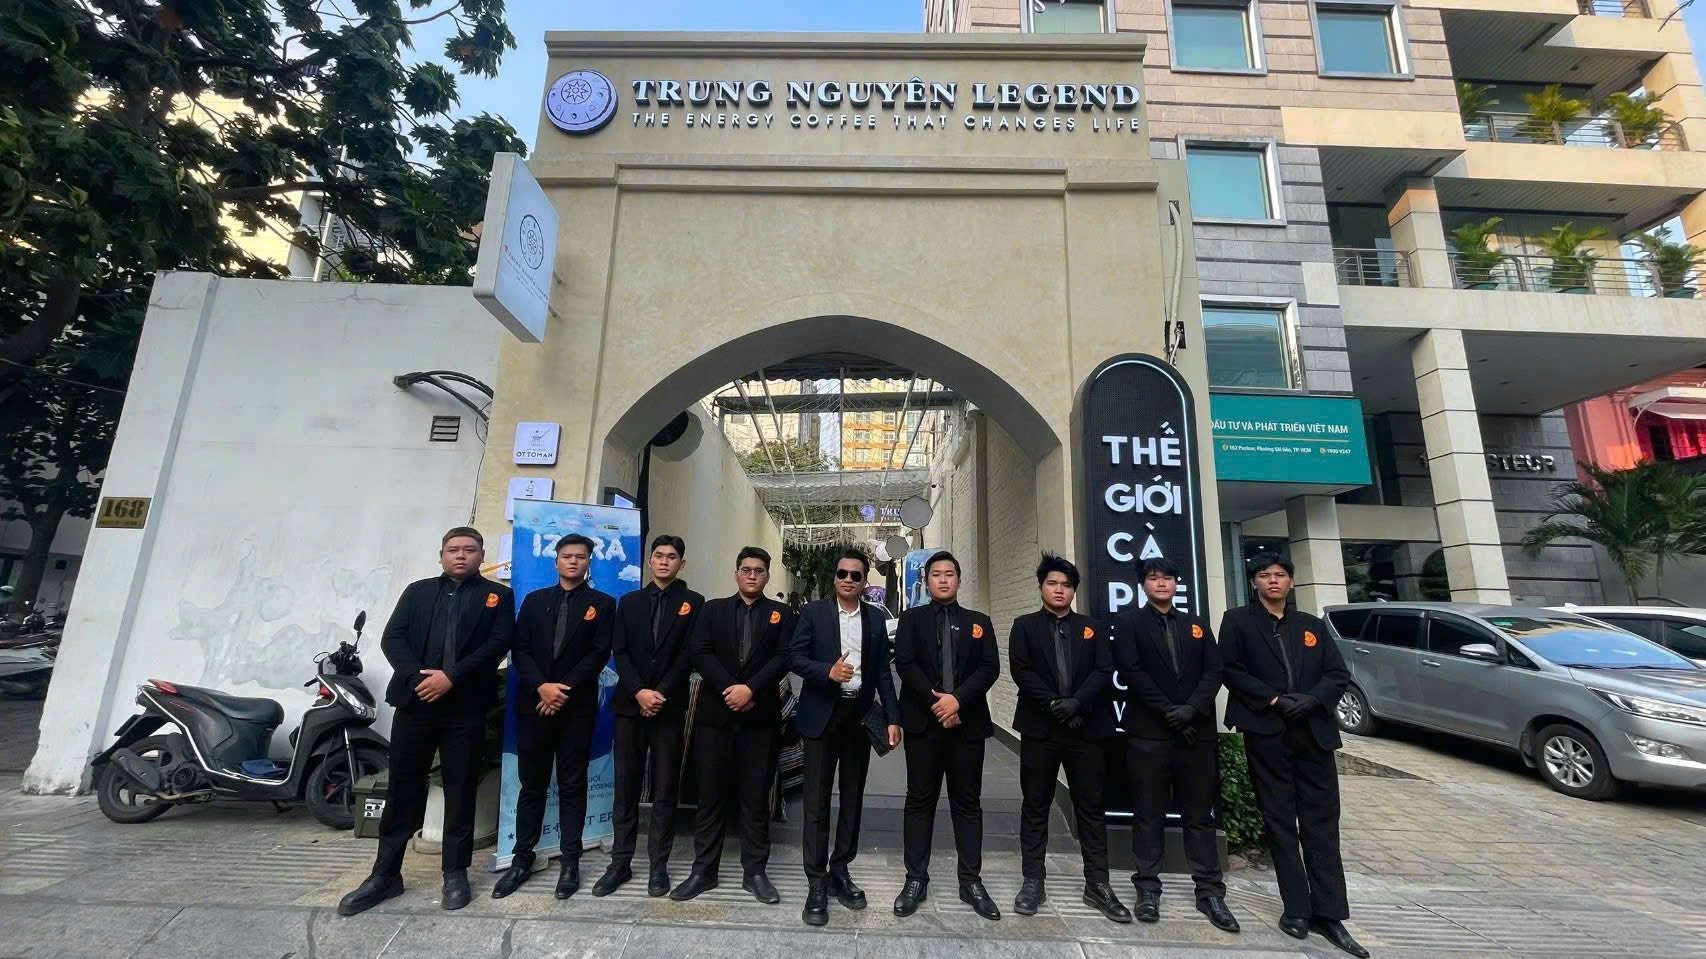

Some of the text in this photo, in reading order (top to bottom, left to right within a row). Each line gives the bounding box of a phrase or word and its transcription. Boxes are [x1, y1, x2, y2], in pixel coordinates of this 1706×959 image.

[632, 76, 1140, 111] TRUNG NGUYÊN LEGEND
[632, 112, 1139, 131] THE ENERGY COFFEE THAT CHANGES LIFE
[1228, 421, 1240, 430] TƯ
[1241, 421, 1253, 430] VÀ
[1255, 421, 1277, 432] PHÁT
[1307, 423, 1326, 434] VIỆT
[1328, 424, 1349, 433] NAM
[1102, 421, 1181, 466] THẾ
[104, 499, 144, 518] 168
[1105, 474, 1182, 514] GIỚI
[532, 533, 627, 561] IZRA
[1107, 522, 1164, 561] CÀ
